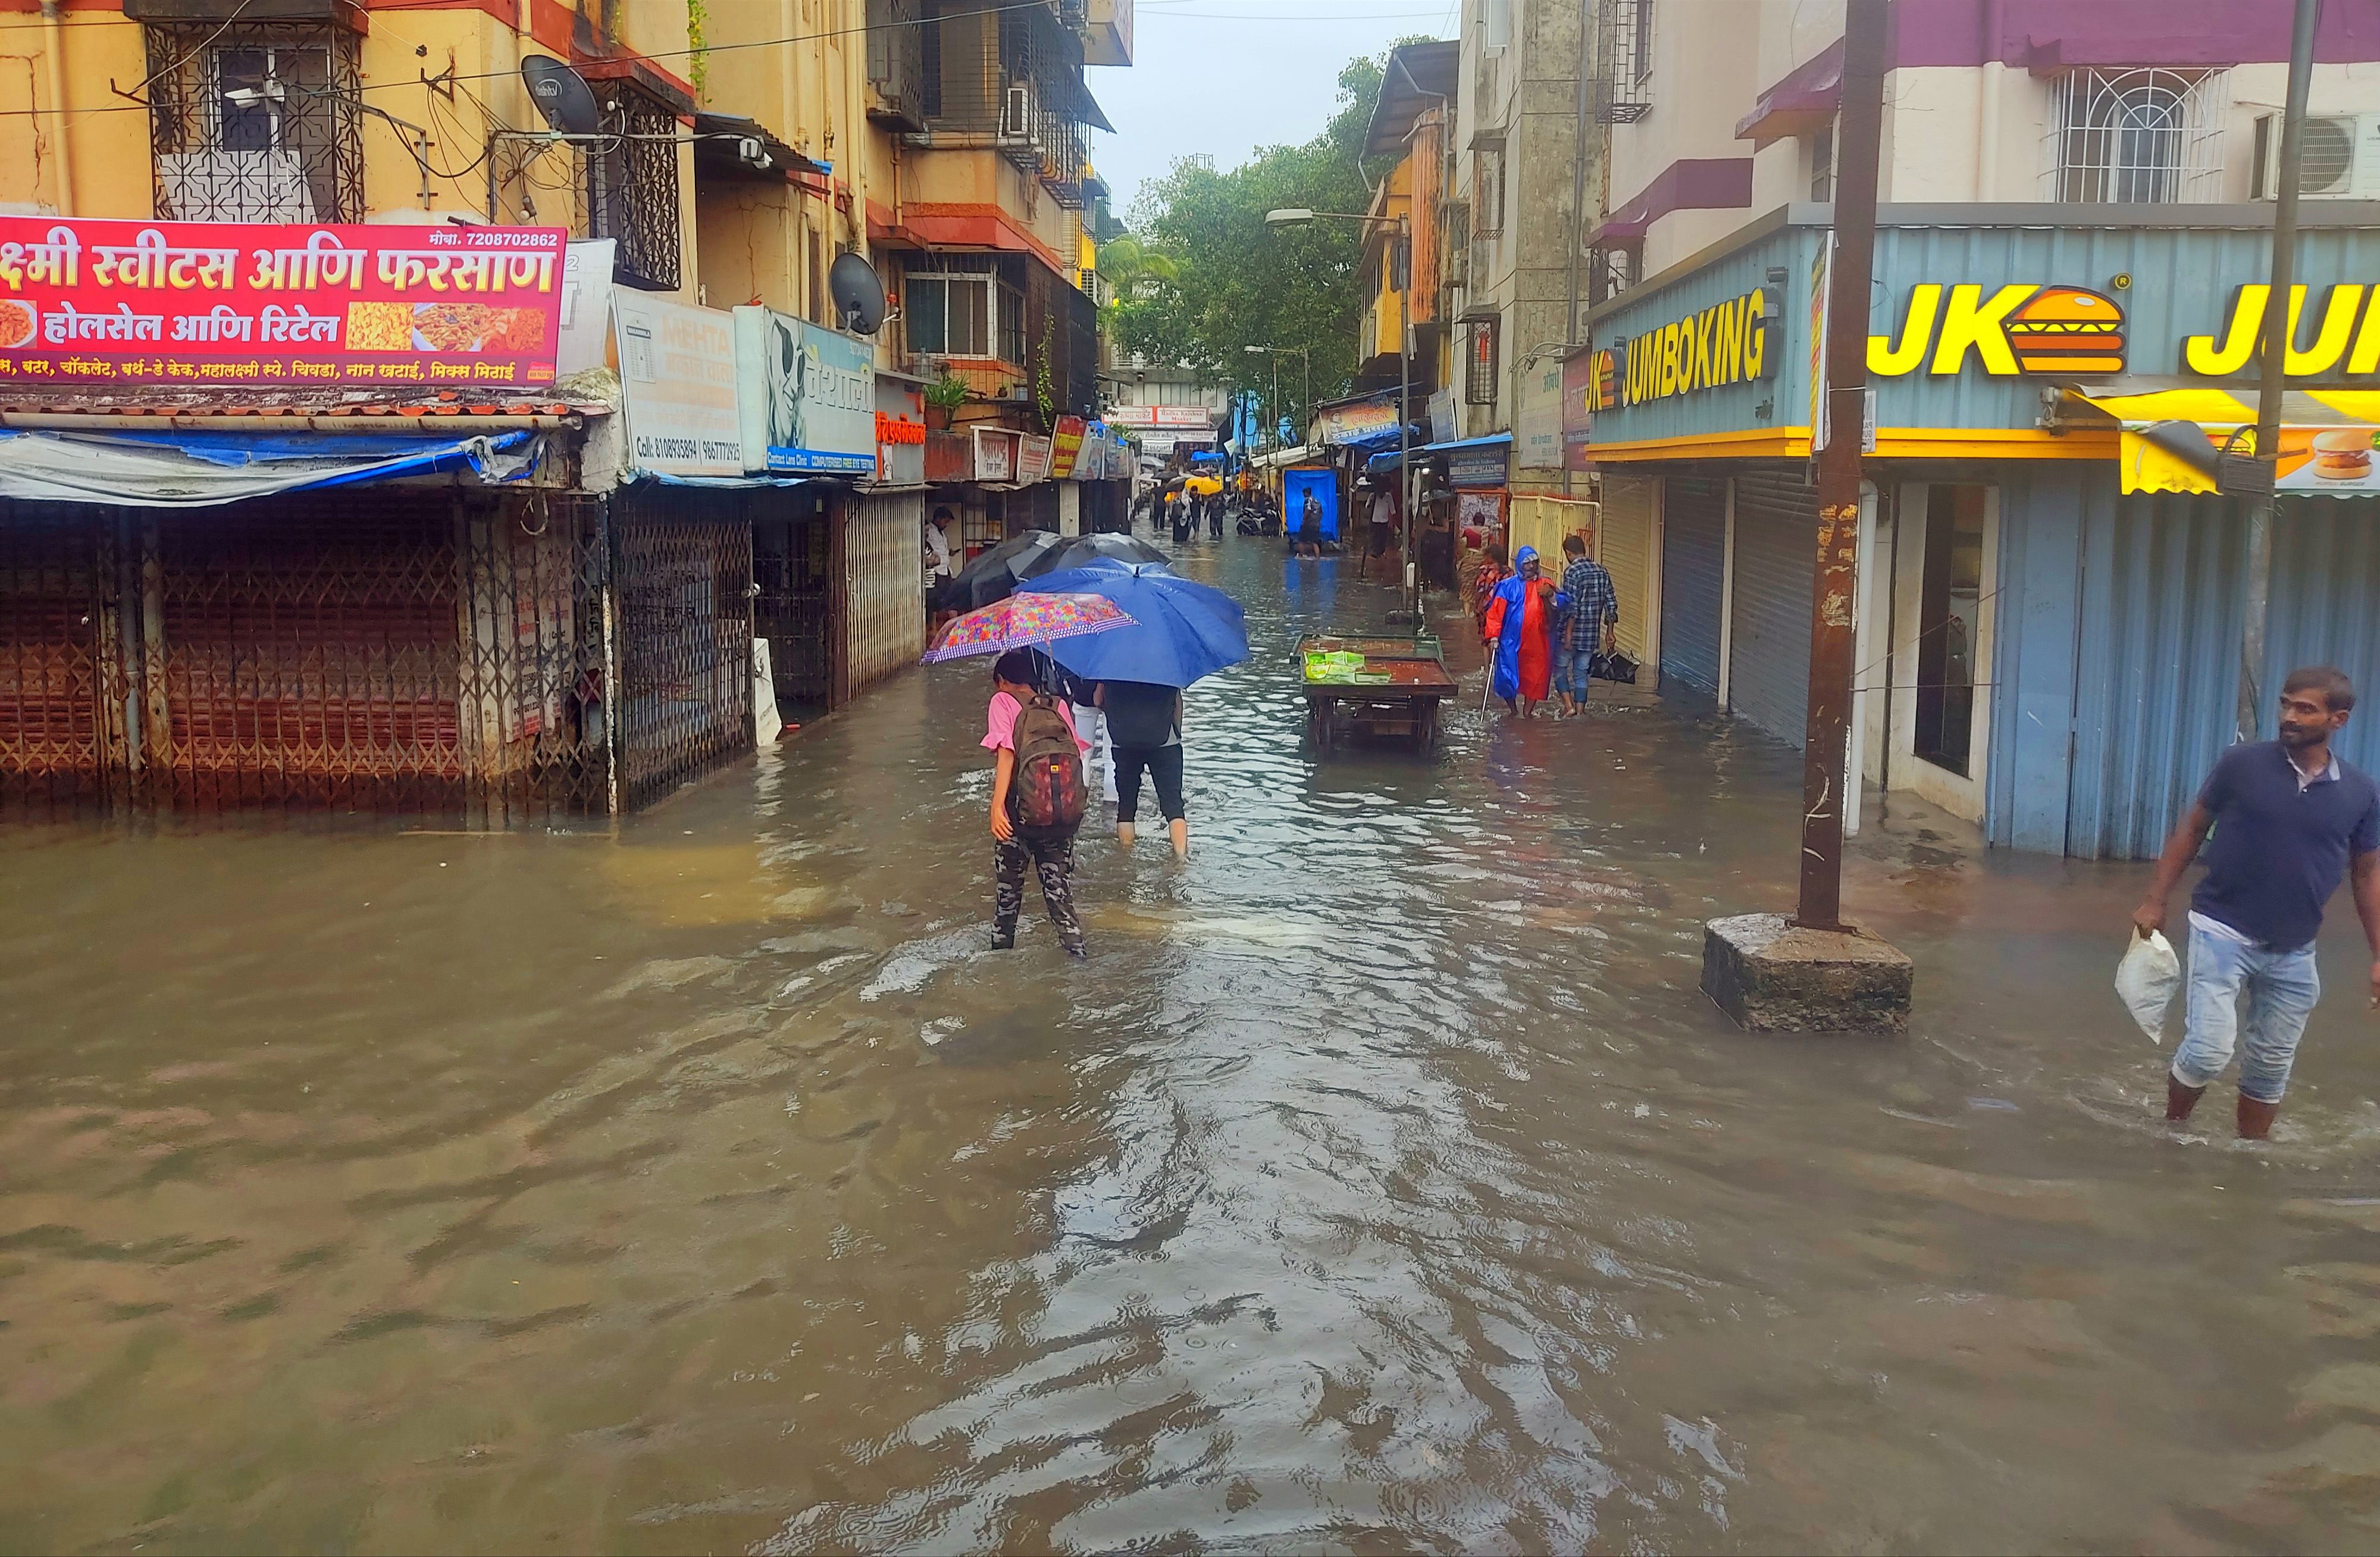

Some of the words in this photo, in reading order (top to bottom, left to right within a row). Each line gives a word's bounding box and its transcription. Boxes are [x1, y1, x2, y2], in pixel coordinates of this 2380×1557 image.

[91, 229, 239, 290] स्वीटस
[248, 230, 368, 291] आणि
[377, 249, 558, 293] फरसाण
[466, 233, 558, 247] 7208702862
[42, 301, 164, 344] होलसेल
[170, 304, 254, 342] आणि
[260, 304, 341, 343] रिटेल
[662, 314, 731, 358] MEHTA
[1866, 283, 2044, 376] JK
[60, 355, 117, 379] चॉकलेट,
[346, 362, 375, 378] नान
[430, 361, 471, 380] मिक्स
[474, 361, 516, 382] मिठाई
[1622, 287, 1765, 408] JUMBOKING
[1584, 349, 1606, 414] JK
[637, 435, 654, 459] Call:
[655, 437, 697, 459] 8108935894
[703, 440, 741, 462] 9867772925
[768, 451, 785, 465] Contact
[785, 453, 796, 465] Lens
[843, 457, 853, 468] FREE
